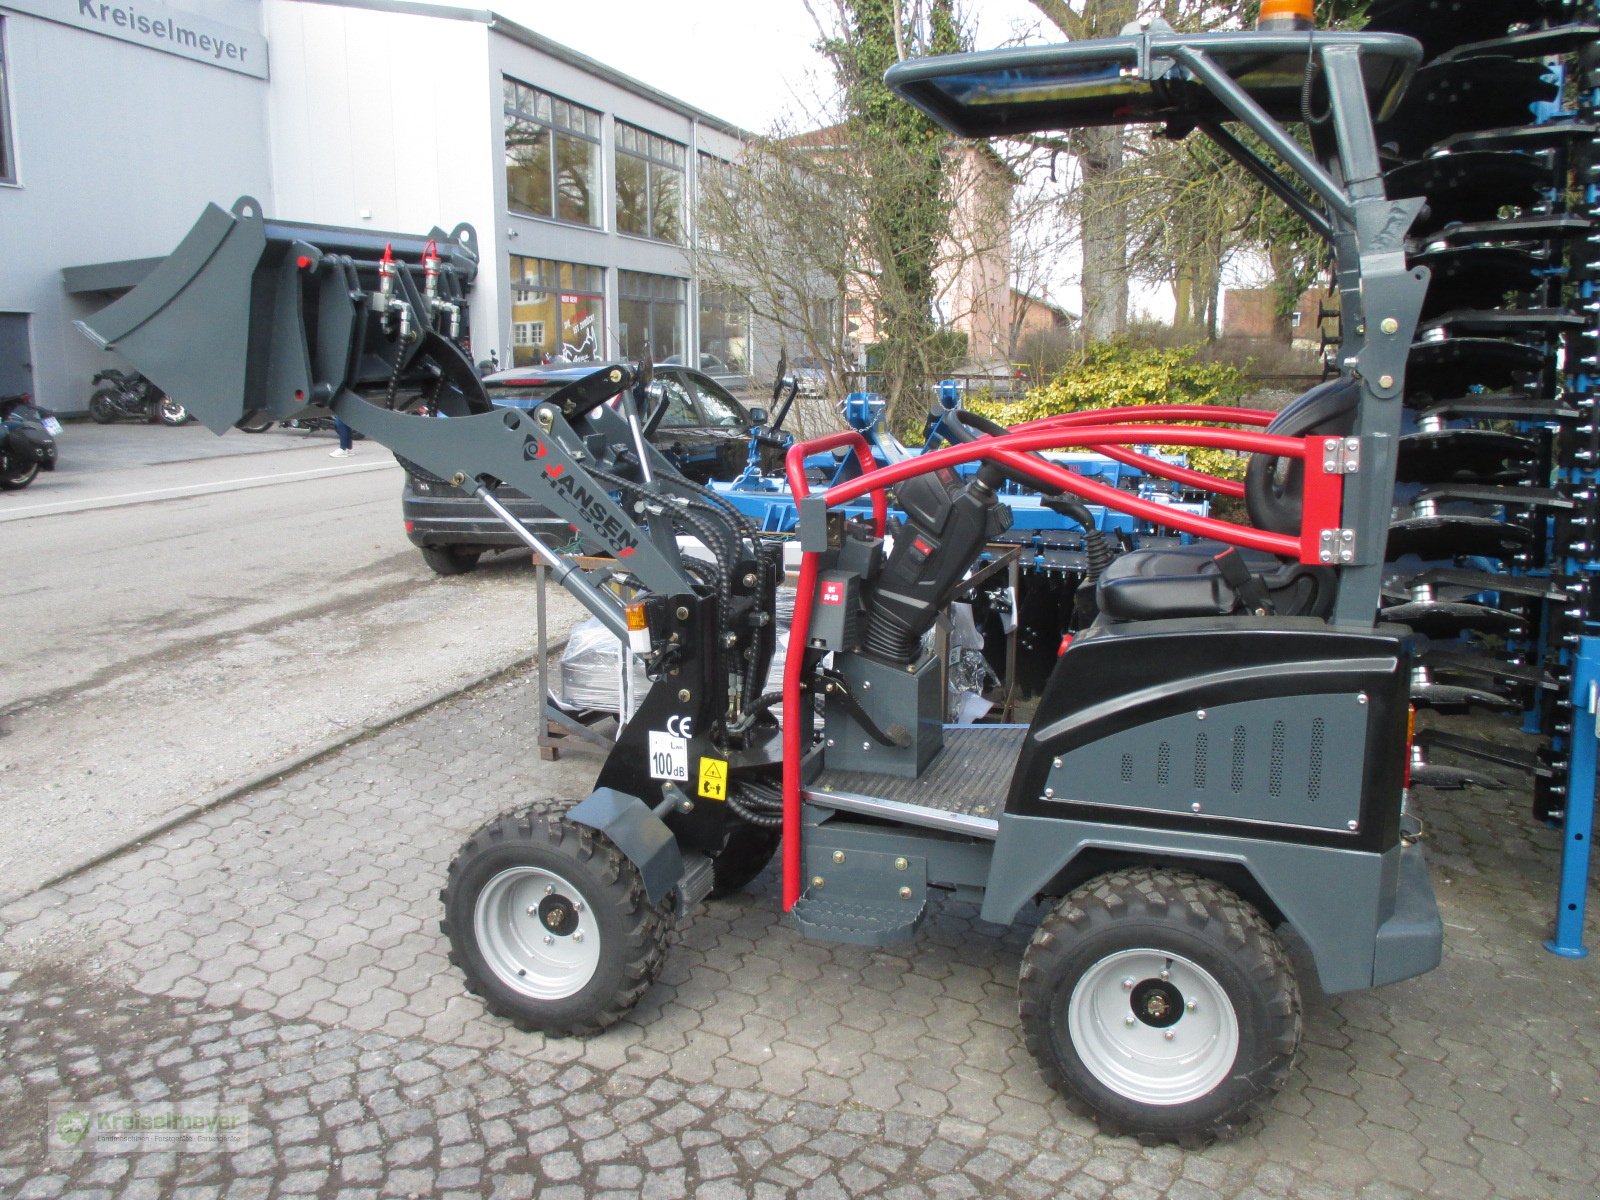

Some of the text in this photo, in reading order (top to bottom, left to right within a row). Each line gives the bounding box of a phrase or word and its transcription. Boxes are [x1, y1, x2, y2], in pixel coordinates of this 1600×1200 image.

[78, 0, 248, 62] Kreiselmeyer
[540, 470, 622, 552] HL-500
[545, 463, 639, 550] JANSEN
[667, 715, 693, 739] CE
[652, 751, 685, 777] 100 dB
